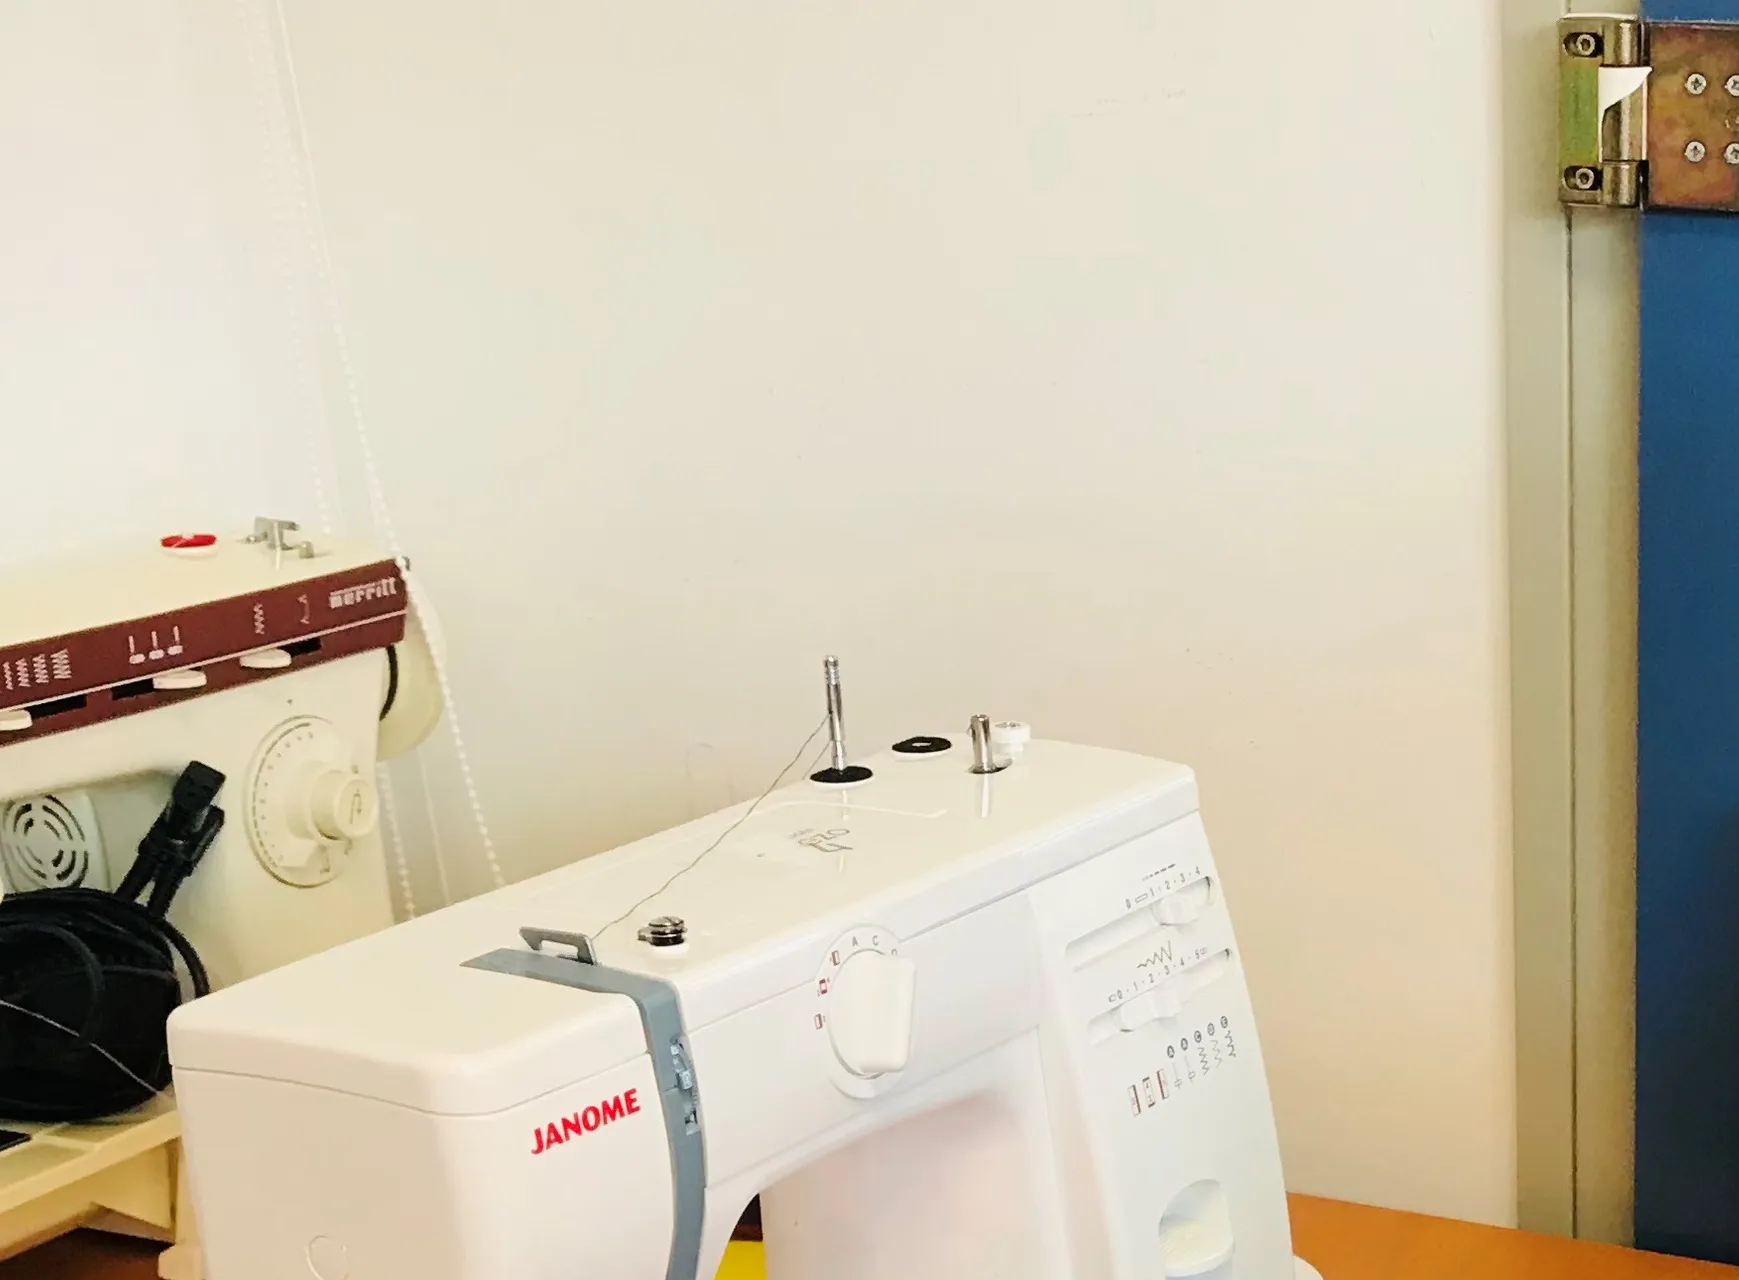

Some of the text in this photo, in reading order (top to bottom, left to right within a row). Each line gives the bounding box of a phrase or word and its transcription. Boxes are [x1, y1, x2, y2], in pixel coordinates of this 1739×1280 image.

[1164, 880, 1171, 890] 2
[852, 935, 879, 947] A C
[531, 1087, 641, 1155] JANOME
